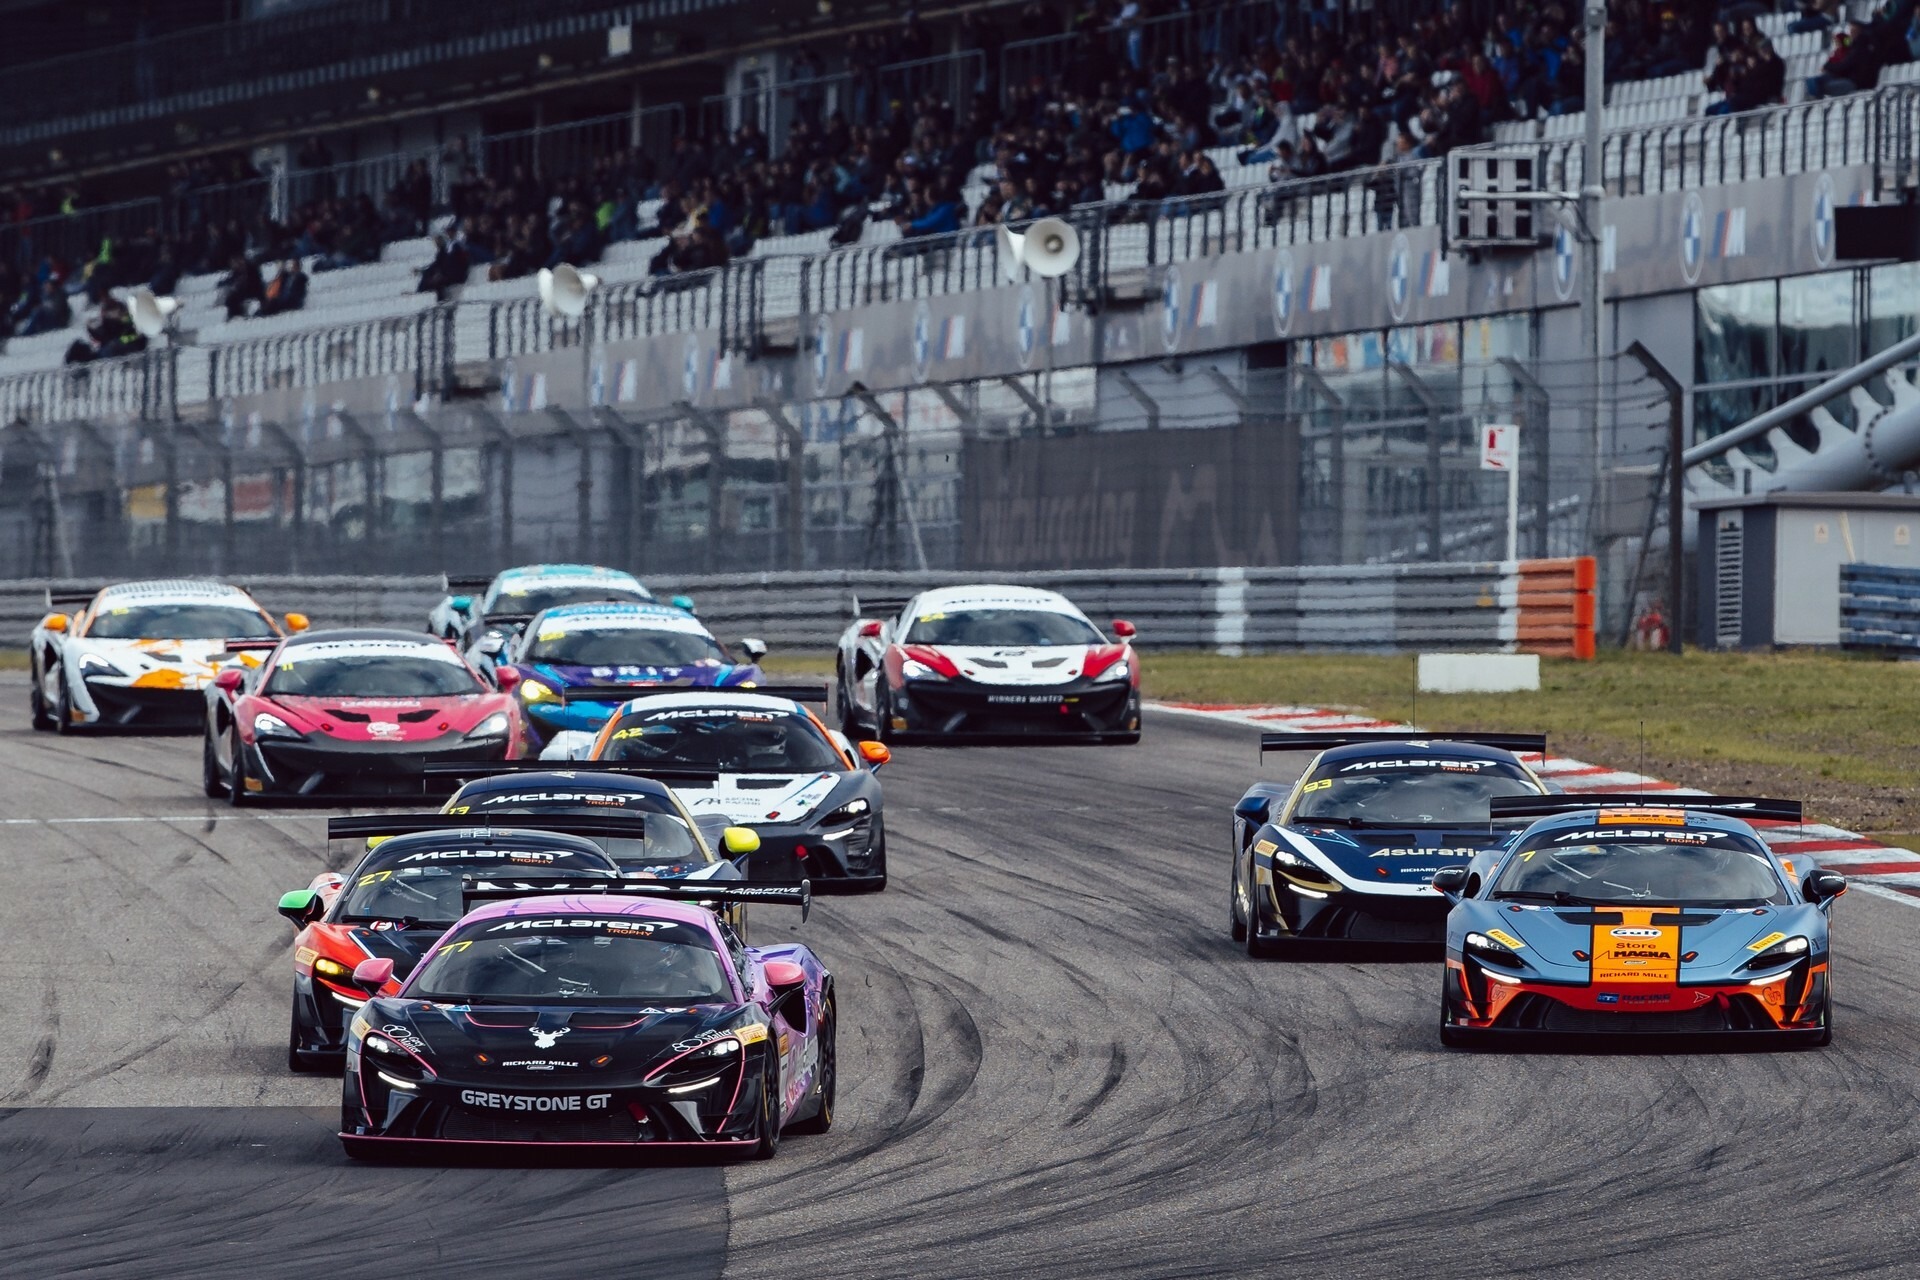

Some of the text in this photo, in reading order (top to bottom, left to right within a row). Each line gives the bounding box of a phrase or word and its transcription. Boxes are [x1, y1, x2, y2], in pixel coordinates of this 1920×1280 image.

[644, 709, 789, 722] McLaren
[612, 727, 643, 740] 42
[1340, 759, 1497, 772] McLaren
[1303, 778, 1332, 793] 93
[482, 793, 645, 804] McLaren
[1554, 829, 1729, 842] McLaren
[398, 849, 575, 862] McLaren
[510, 857, 553, 865] TROPHY
[358, 870, 393, 887] 27
[486, 919, 679, 933] McLaren
[606, 928, 653, 937] TROPHY
[1612, 928, 1660, 936] Gulf
[1491, 930, 1521, 948] PIRELLI
[1752, 933, 1782, 950] PIRELLI
[438, 940, 474, 957] 77
[1613, 950, 1672, 959] MAGNA
[1599, 971, 1640, 979] RICHARD
[501, 1060, 546, 1068] RICHARD
[547, 1060, 579, 1068] MILLE
[461, 1089, 613, 1112] GREYSTONE GT
